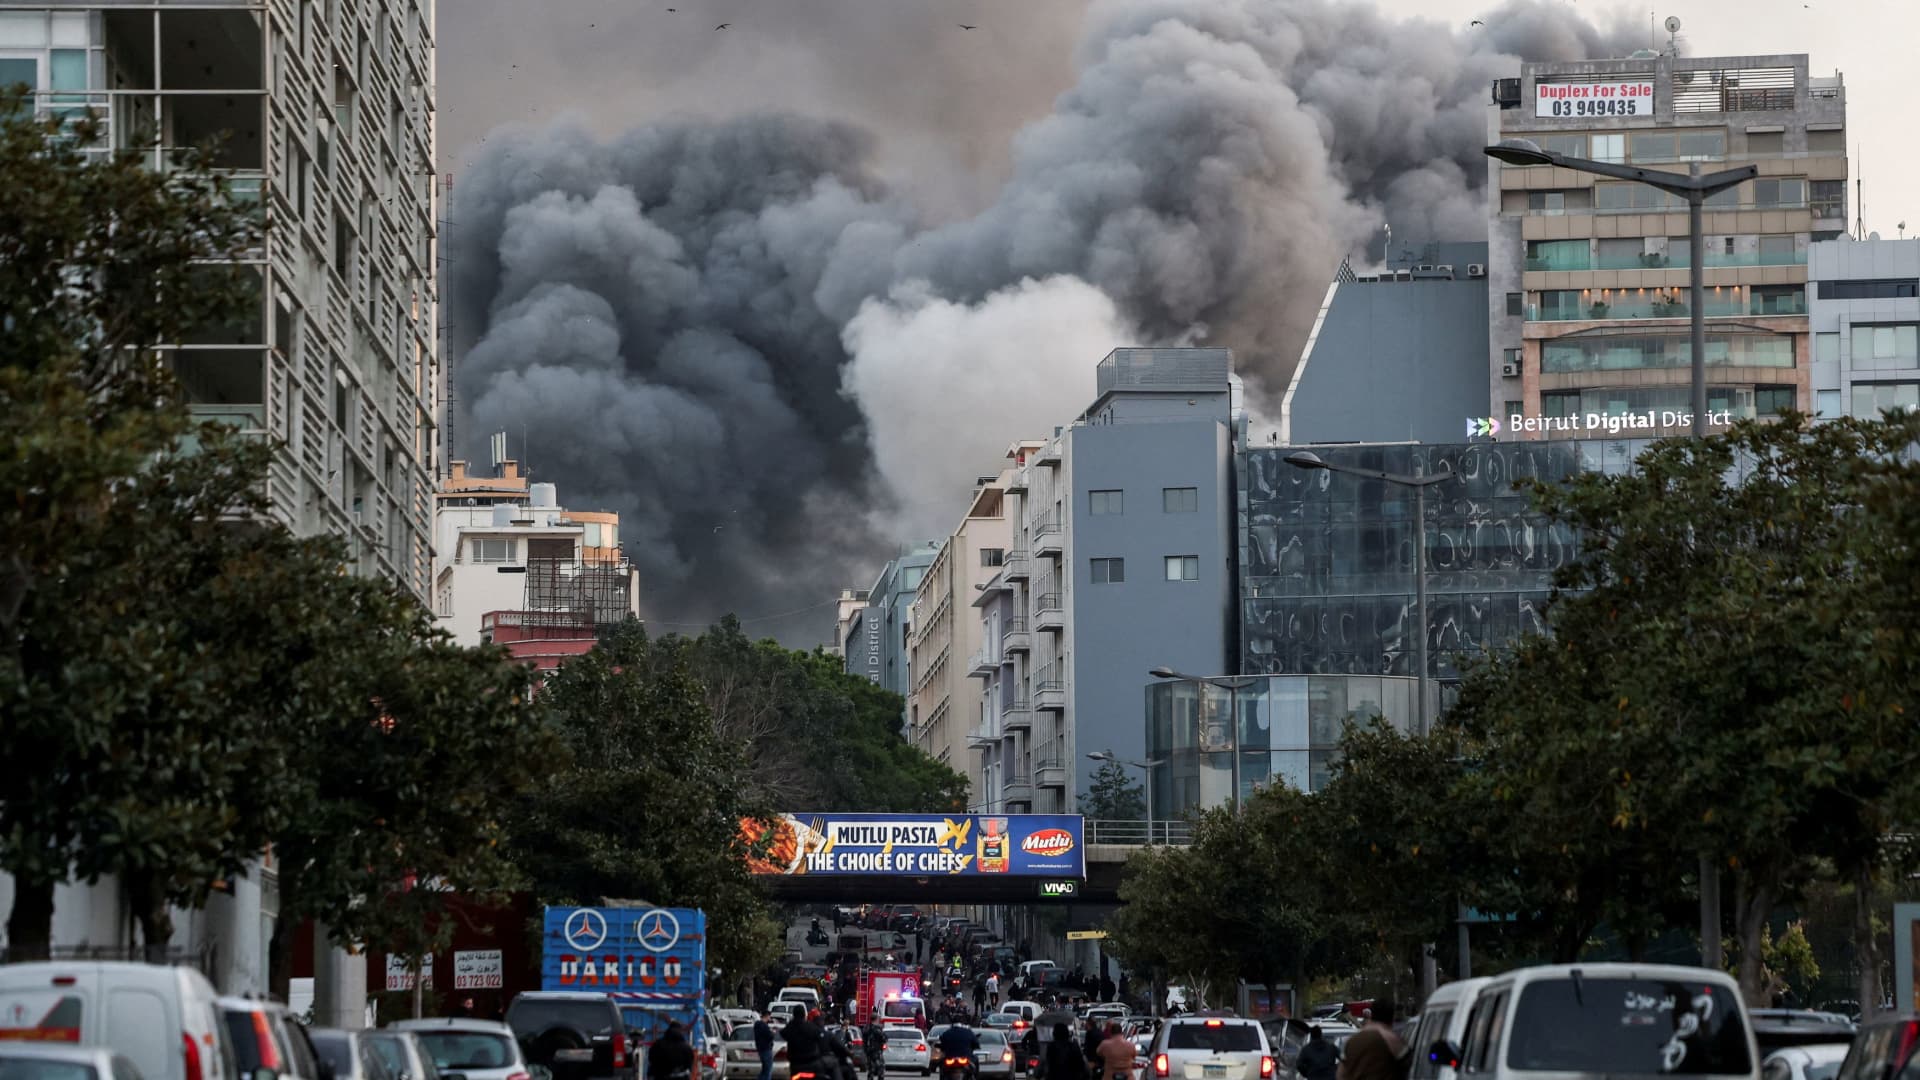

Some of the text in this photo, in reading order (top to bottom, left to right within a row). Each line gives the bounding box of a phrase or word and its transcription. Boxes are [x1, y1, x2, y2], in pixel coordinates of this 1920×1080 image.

[1540, 83, 1651, 100] Duplex For Sale
[1552, 99, 1636, 116] 03 949435
[1511, 412, 1579, 432] Beirut
[1586, 410, 1655, 433] Digital
[868, 616, 879, 665] District
[837, 826, 938, 845] MUTLU PASTA
[806, 852, 963, 872] THE CHOICE OF CHEFS
[457, 974, 501, 987] 03 723 022
